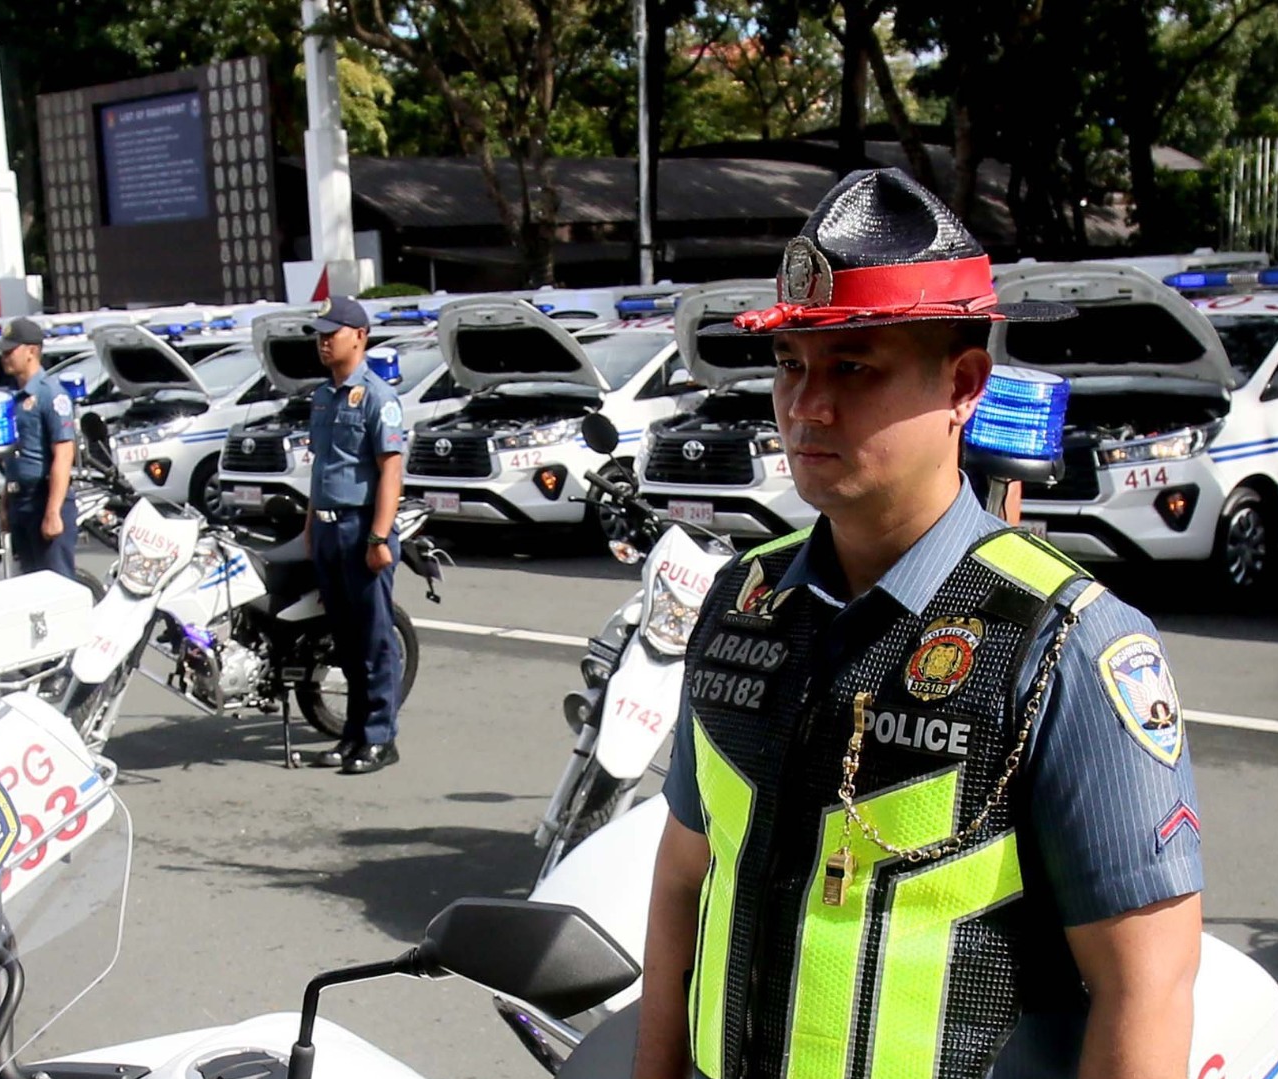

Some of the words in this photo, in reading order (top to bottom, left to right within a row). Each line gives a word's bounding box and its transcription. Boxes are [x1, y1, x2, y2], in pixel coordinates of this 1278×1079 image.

[124, 447, 149, 461] 410
[510, 451, 543, 468] 412
[1125, 467, 1169, 488] 414
[128, 525, 179, 558] PULISYA
[658, 561, 710, 595] PULIS
[705, 633, 783, 668] ARAOS
[930, 628, 973, 640] OFFICER
[692, 669, 765, 709] 375182
[912, 681, 949, 695] 375182
[616, 698, 663, 734] 1742
[864, 709, 971, 755] POLICE
[1, 785, 88, 893] 93
